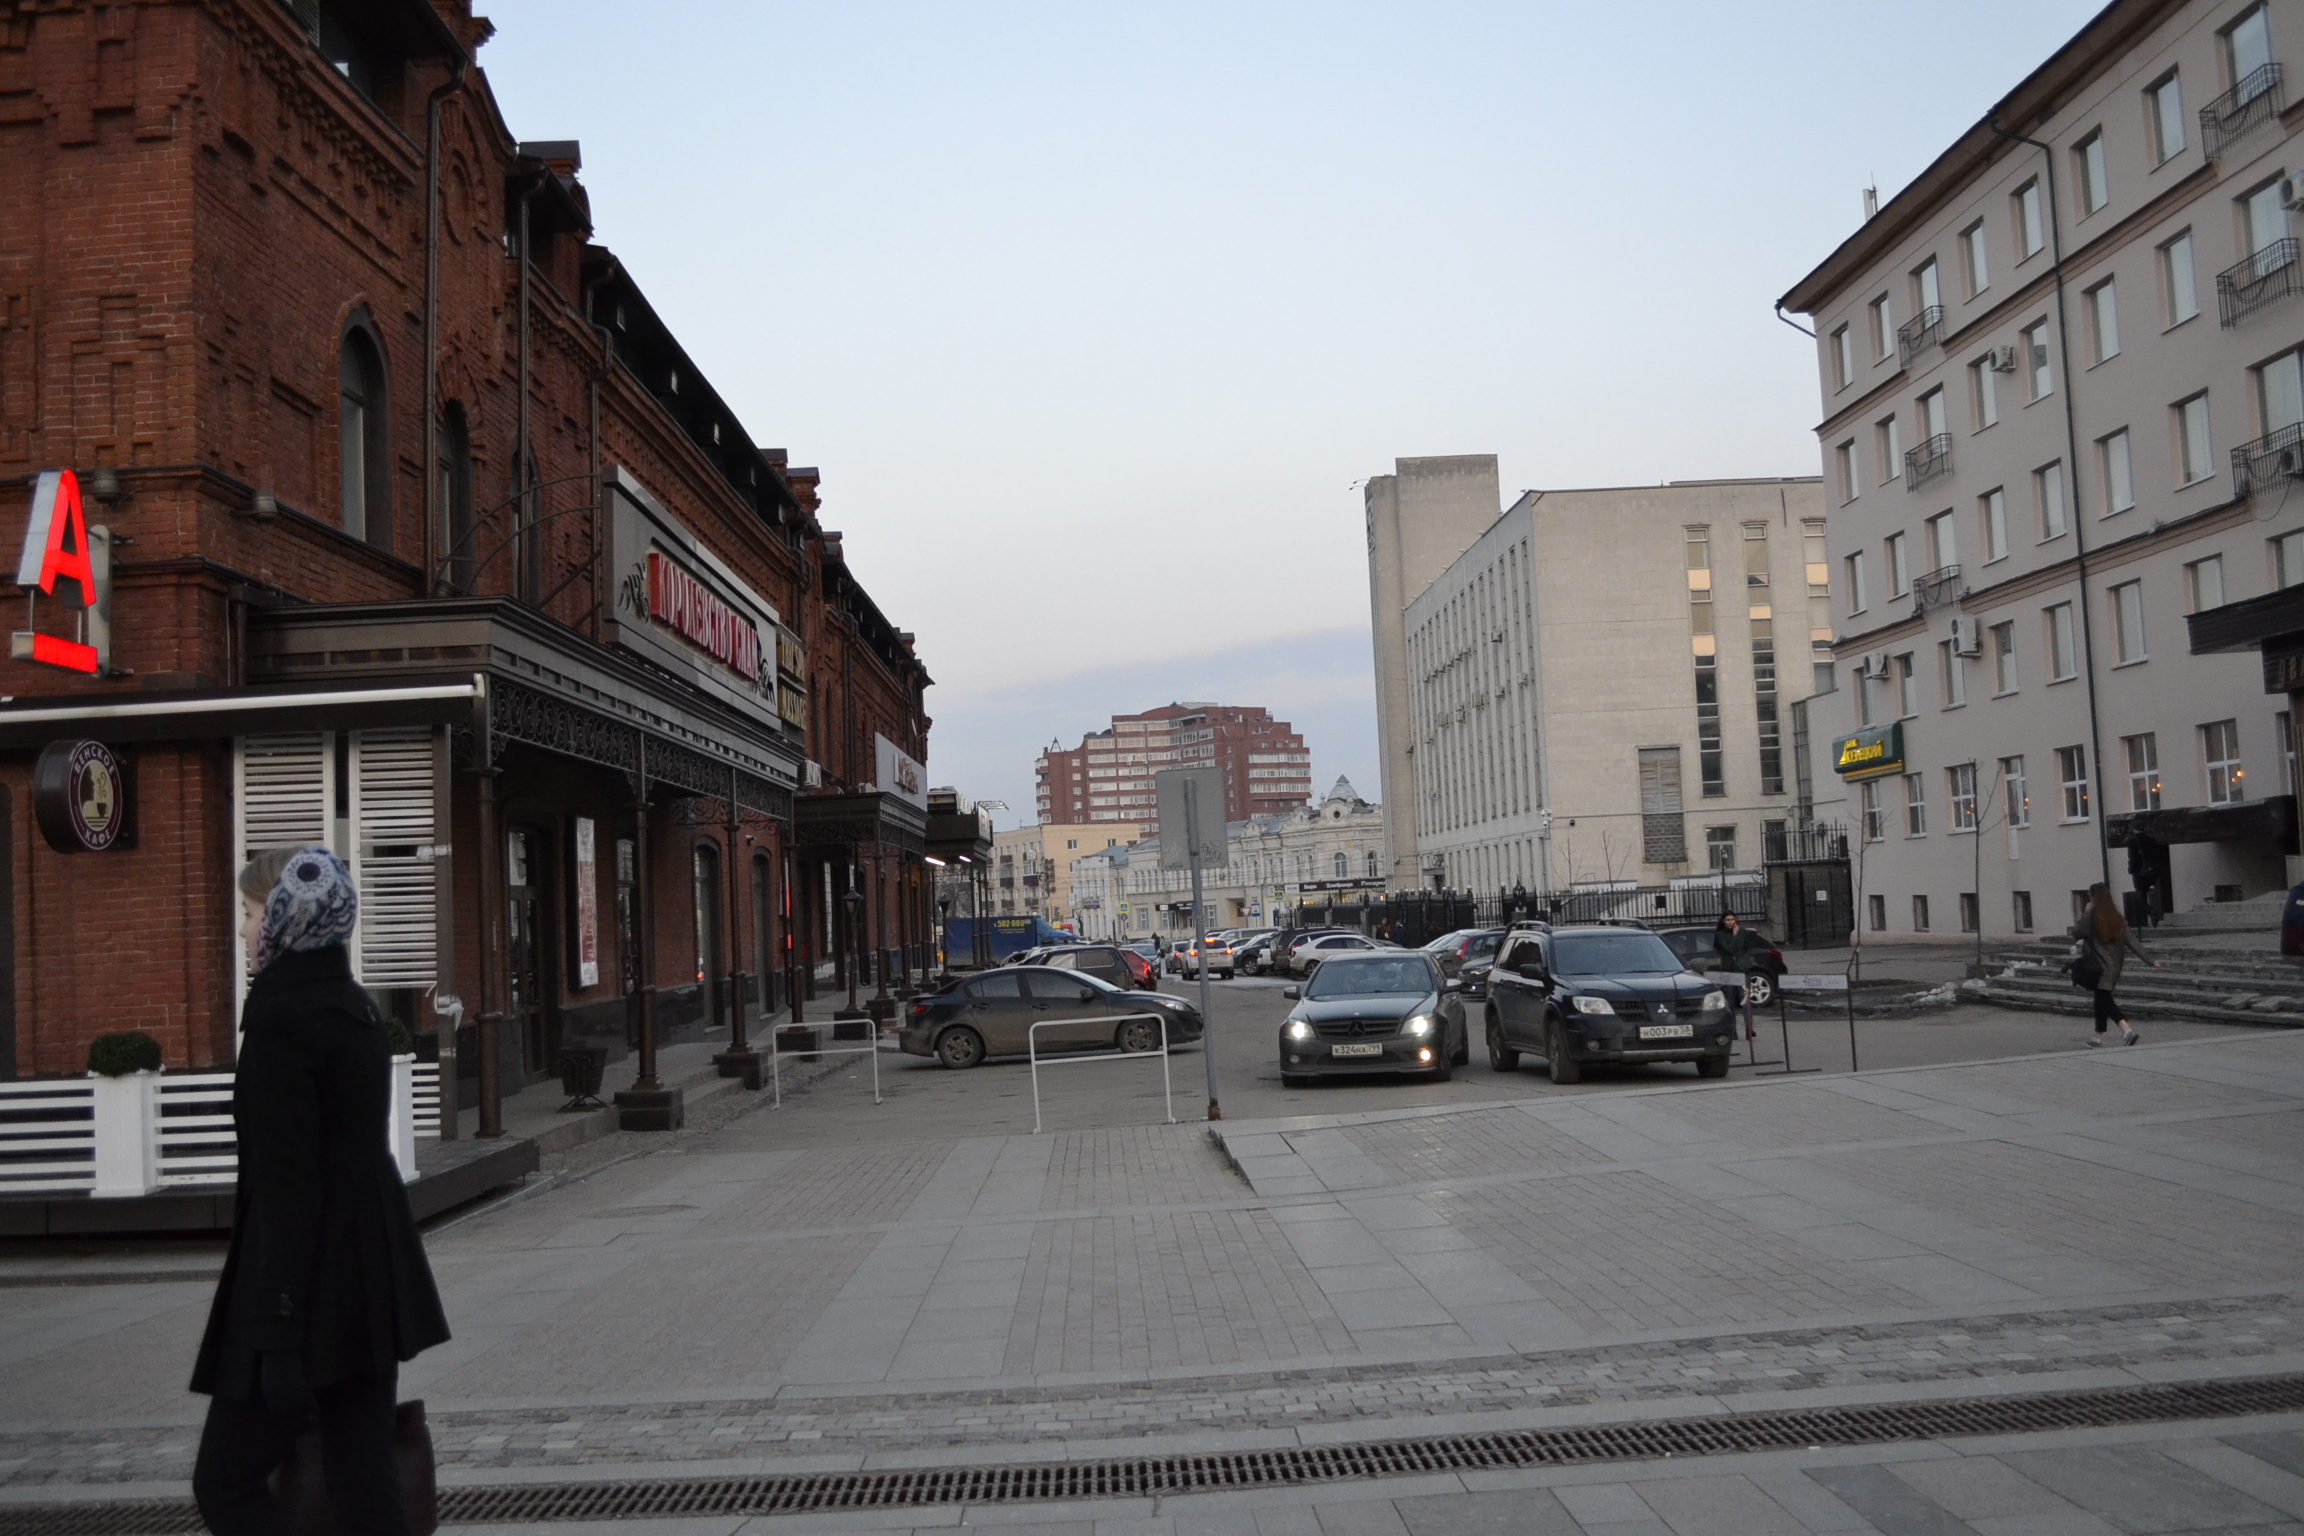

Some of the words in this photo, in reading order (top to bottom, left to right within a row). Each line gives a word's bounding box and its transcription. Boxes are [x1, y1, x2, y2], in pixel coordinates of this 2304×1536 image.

[657, 554, 733, 665] КОРОЛЕВСТВО
[734, 614, 759, 682] СИАМ
[74, 745, 115, 775] ВЕНСКОЕ
[1846, 740, 1884, 763] КУЗНЕЦКИЙ
[85, 828, 111, 845] КАФЕ
